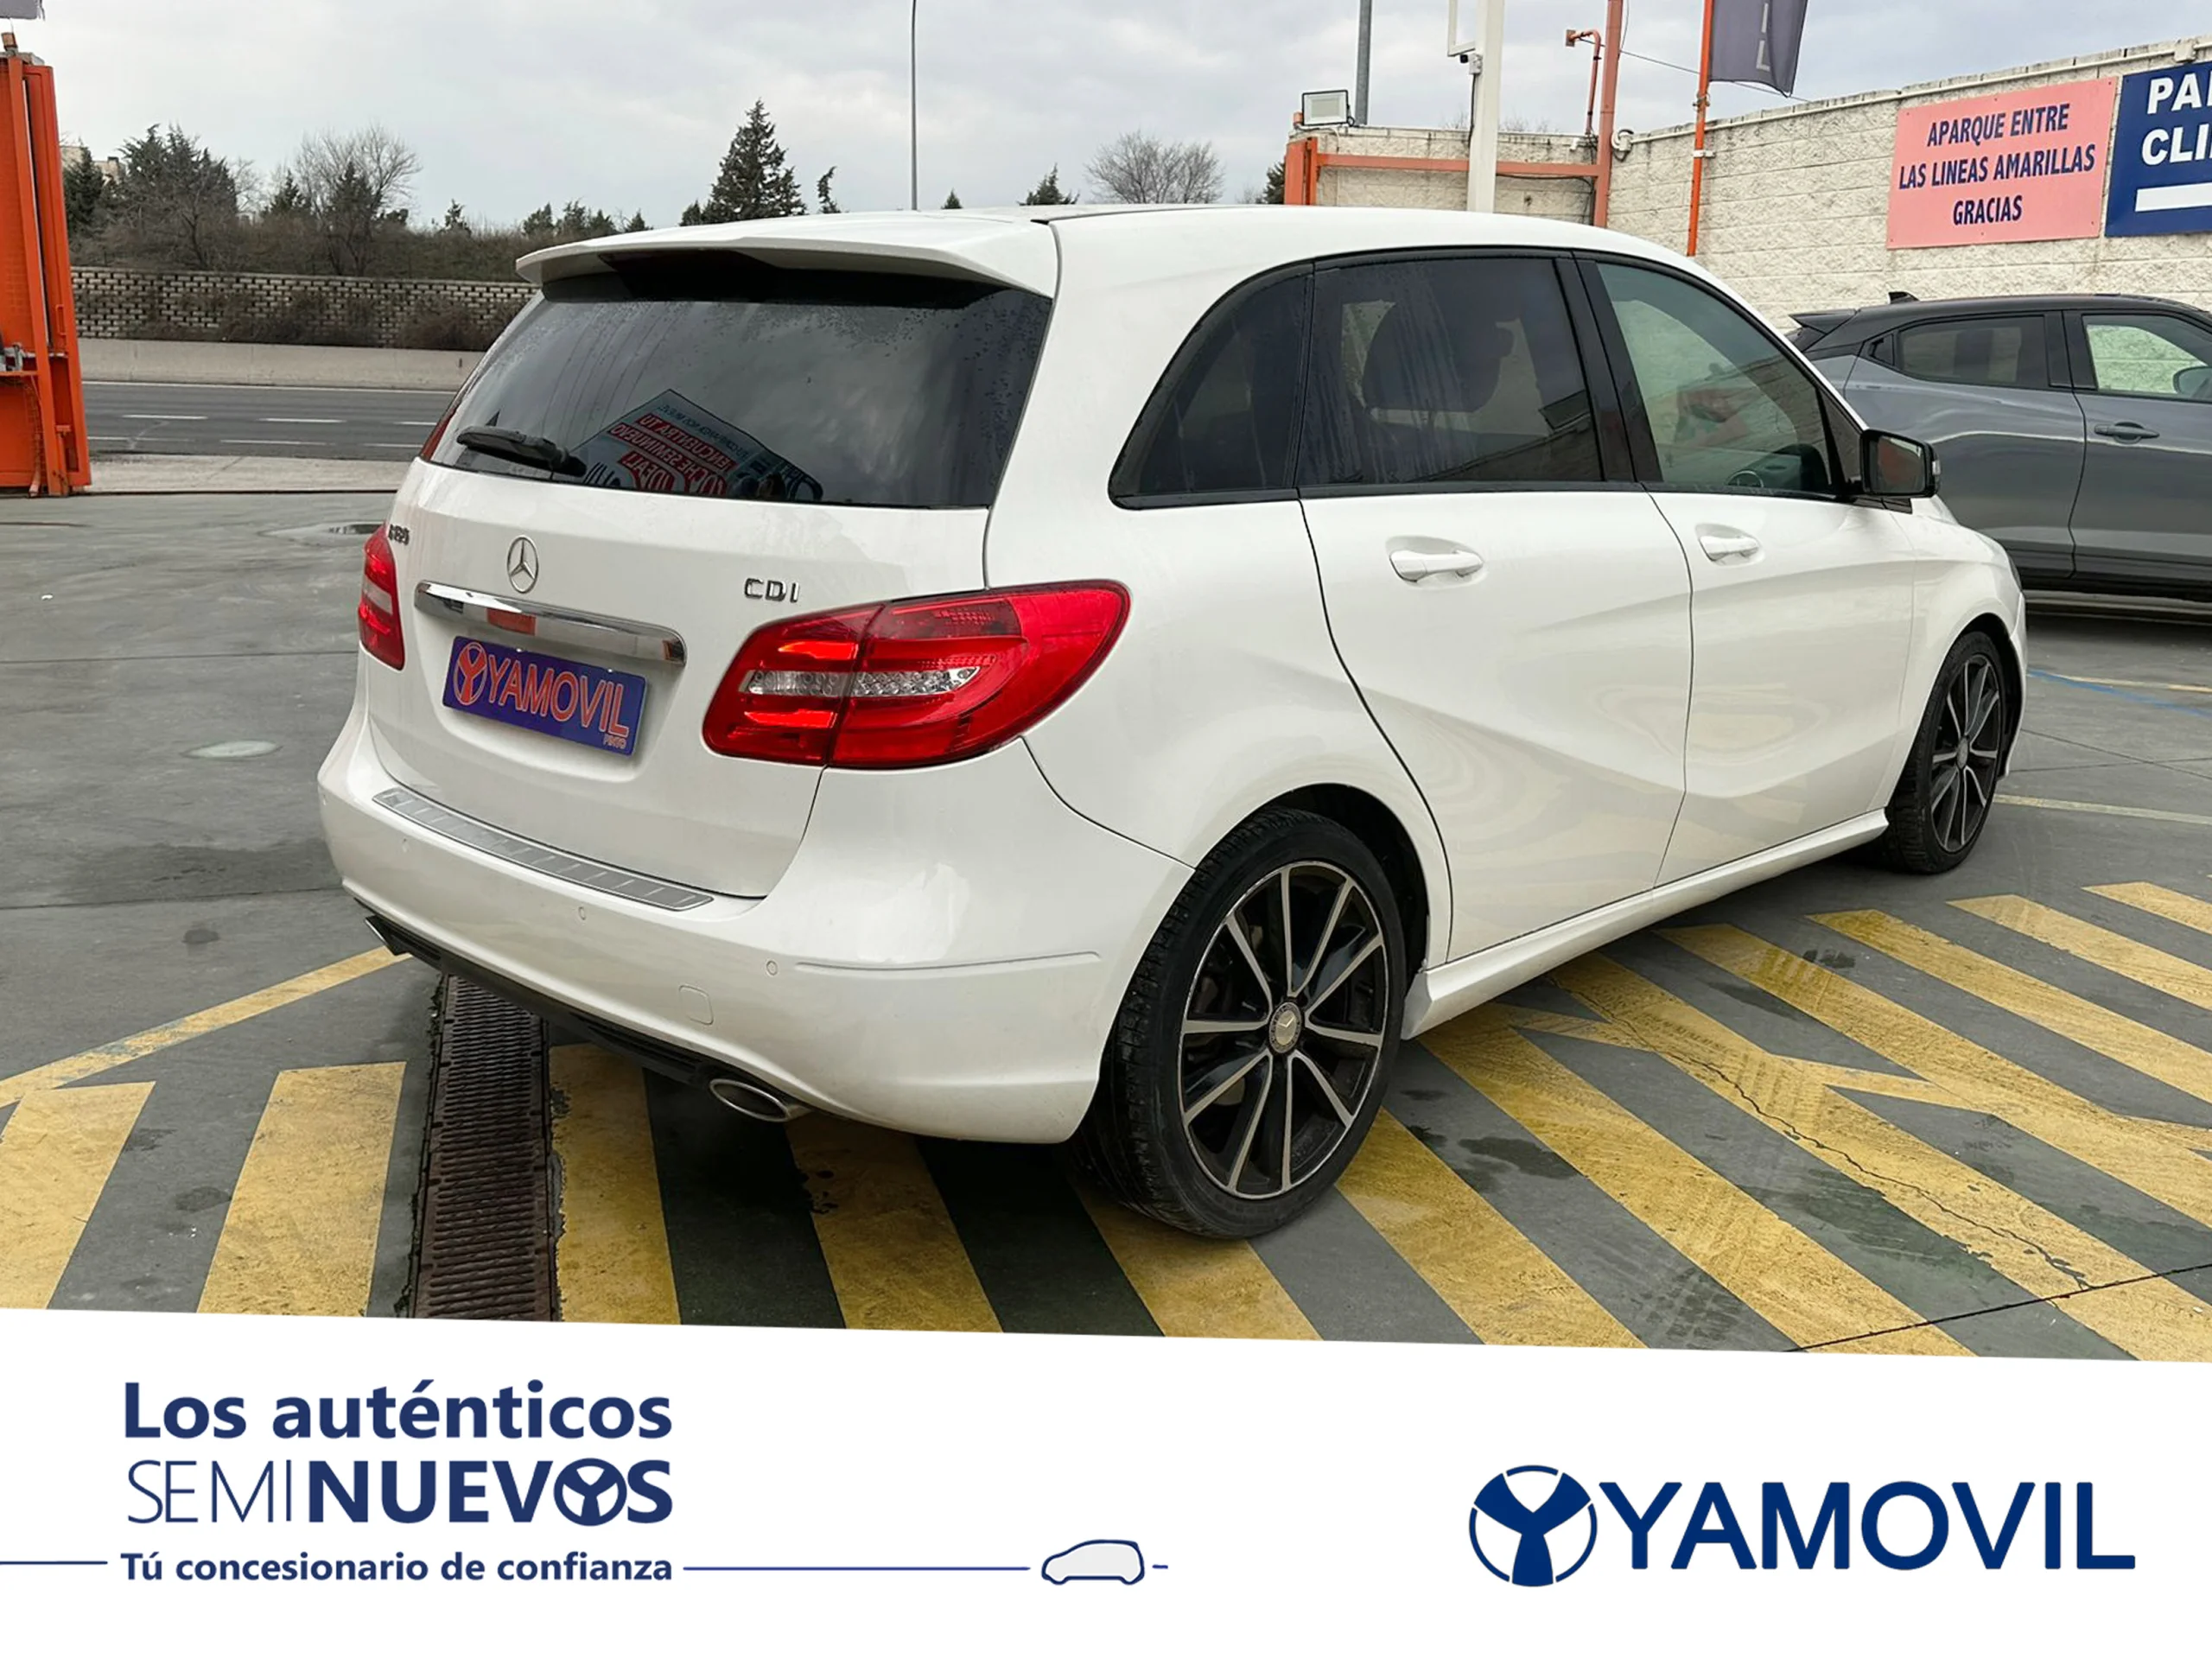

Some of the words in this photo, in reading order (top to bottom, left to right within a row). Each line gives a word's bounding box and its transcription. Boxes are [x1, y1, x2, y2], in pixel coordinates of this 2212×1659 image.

[2147, 70, 2212, 114] PA
[1927, 112, 2005, 147] APARQUE
[2010, 103, 2070, 137] ENTRE
[2142, 124, 2212, 165] CLI
[1898, 162, 1927, 189] LAS
[1931, 156, 1988, 187] LINEAS
[1993, 143, 2095, 181] AMARILLAS
[1953, 194, 2023, 226] GRACIAS
[744, 578, 800, 603] CDI
[488, 654, 629, 738] YAMOVIL
